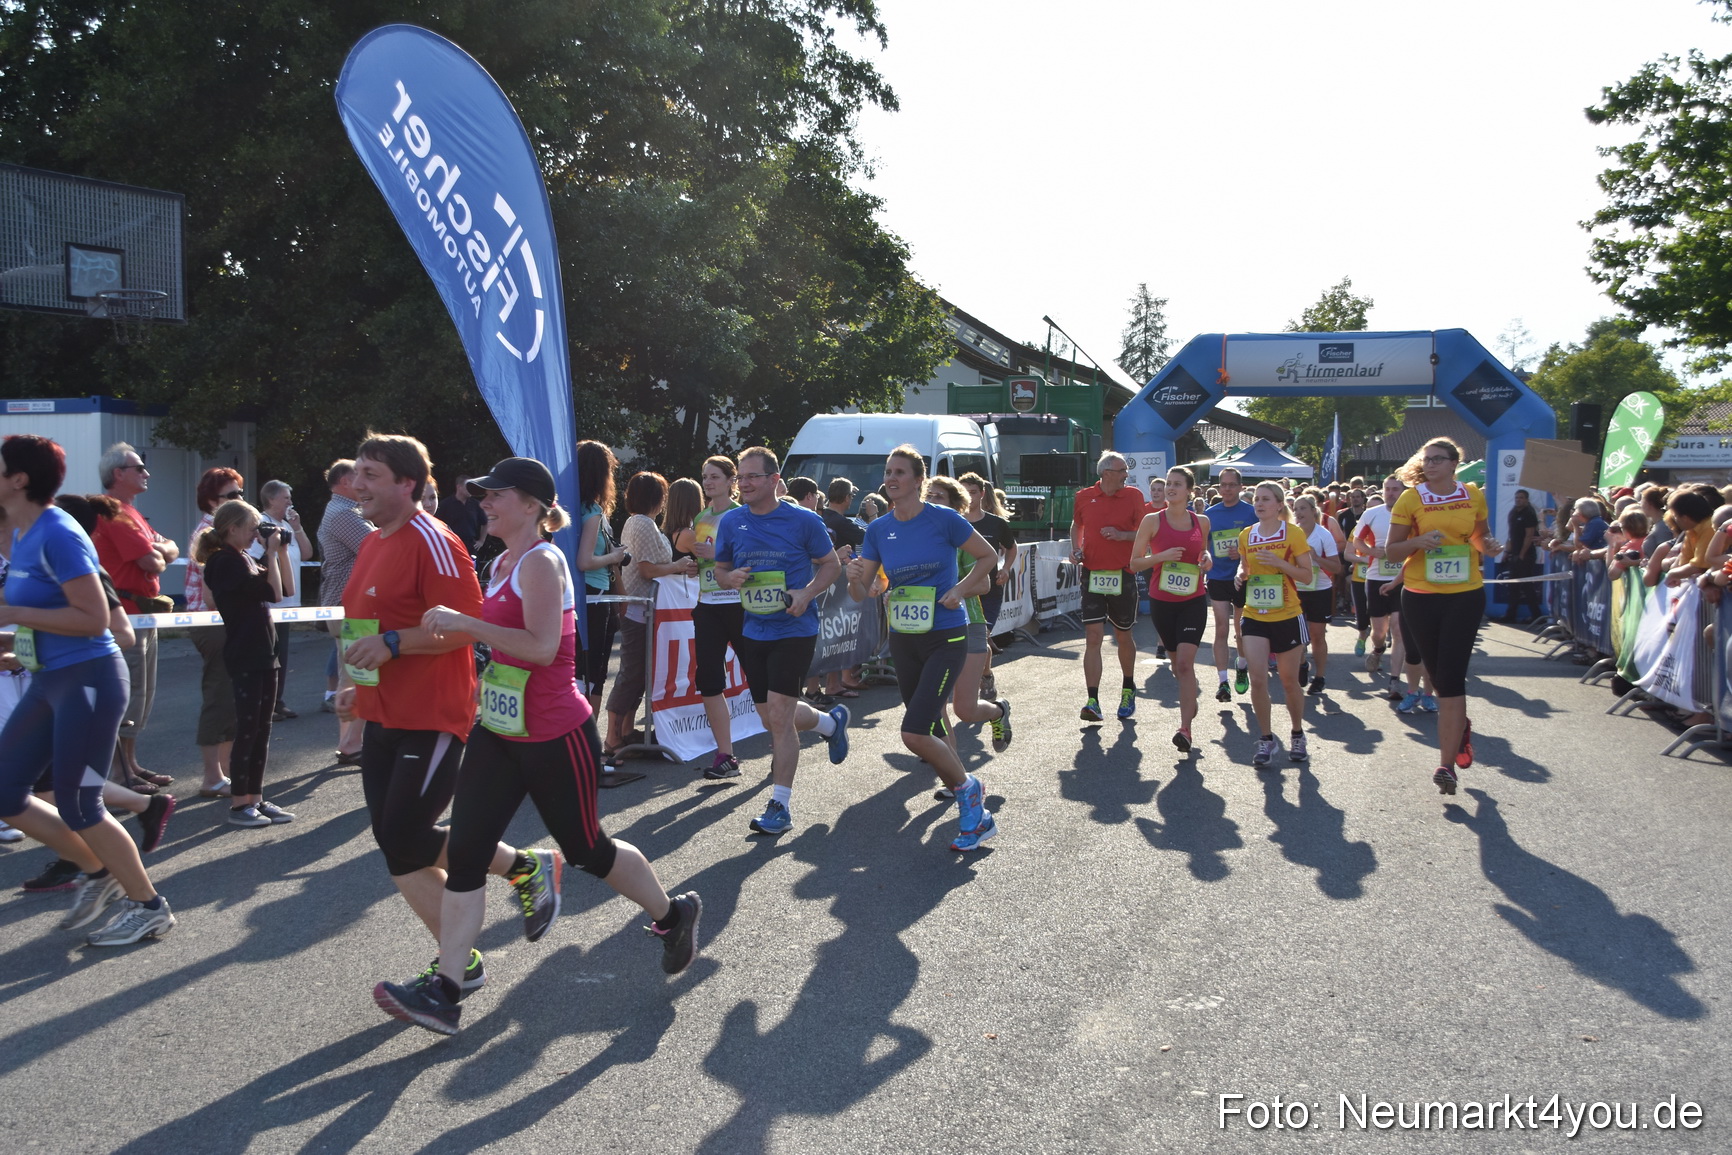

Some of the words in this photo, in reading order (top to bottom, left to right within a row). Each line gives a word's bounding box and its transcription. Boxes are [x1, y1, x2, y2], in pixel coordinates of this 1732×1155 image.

[1306, 363, 1384, 378] firmenlauf
[1161, 391, 1201, 401] Fischer
[1671, 440, 1705, 449] Jura
[1604, 445, 1631, 475] AOK
[1424, 505, 1446, 513] MAX
[1448, 503, 1472, 511] BÖGL
[1216, 538, 1239, 551] 1371
[1434, 561, 1460, 574] 871
[1093, 576, 1119, 587] 1370
[1167, 573, 1191, 588] 908
[744, 588, 782, 604] 1437
[1253, 588, 1276, 600] 918
[893, 604, 930, 620] 1436
[819, 607, 862, 640] ischer
[484, 687, 518, 718] 1368
